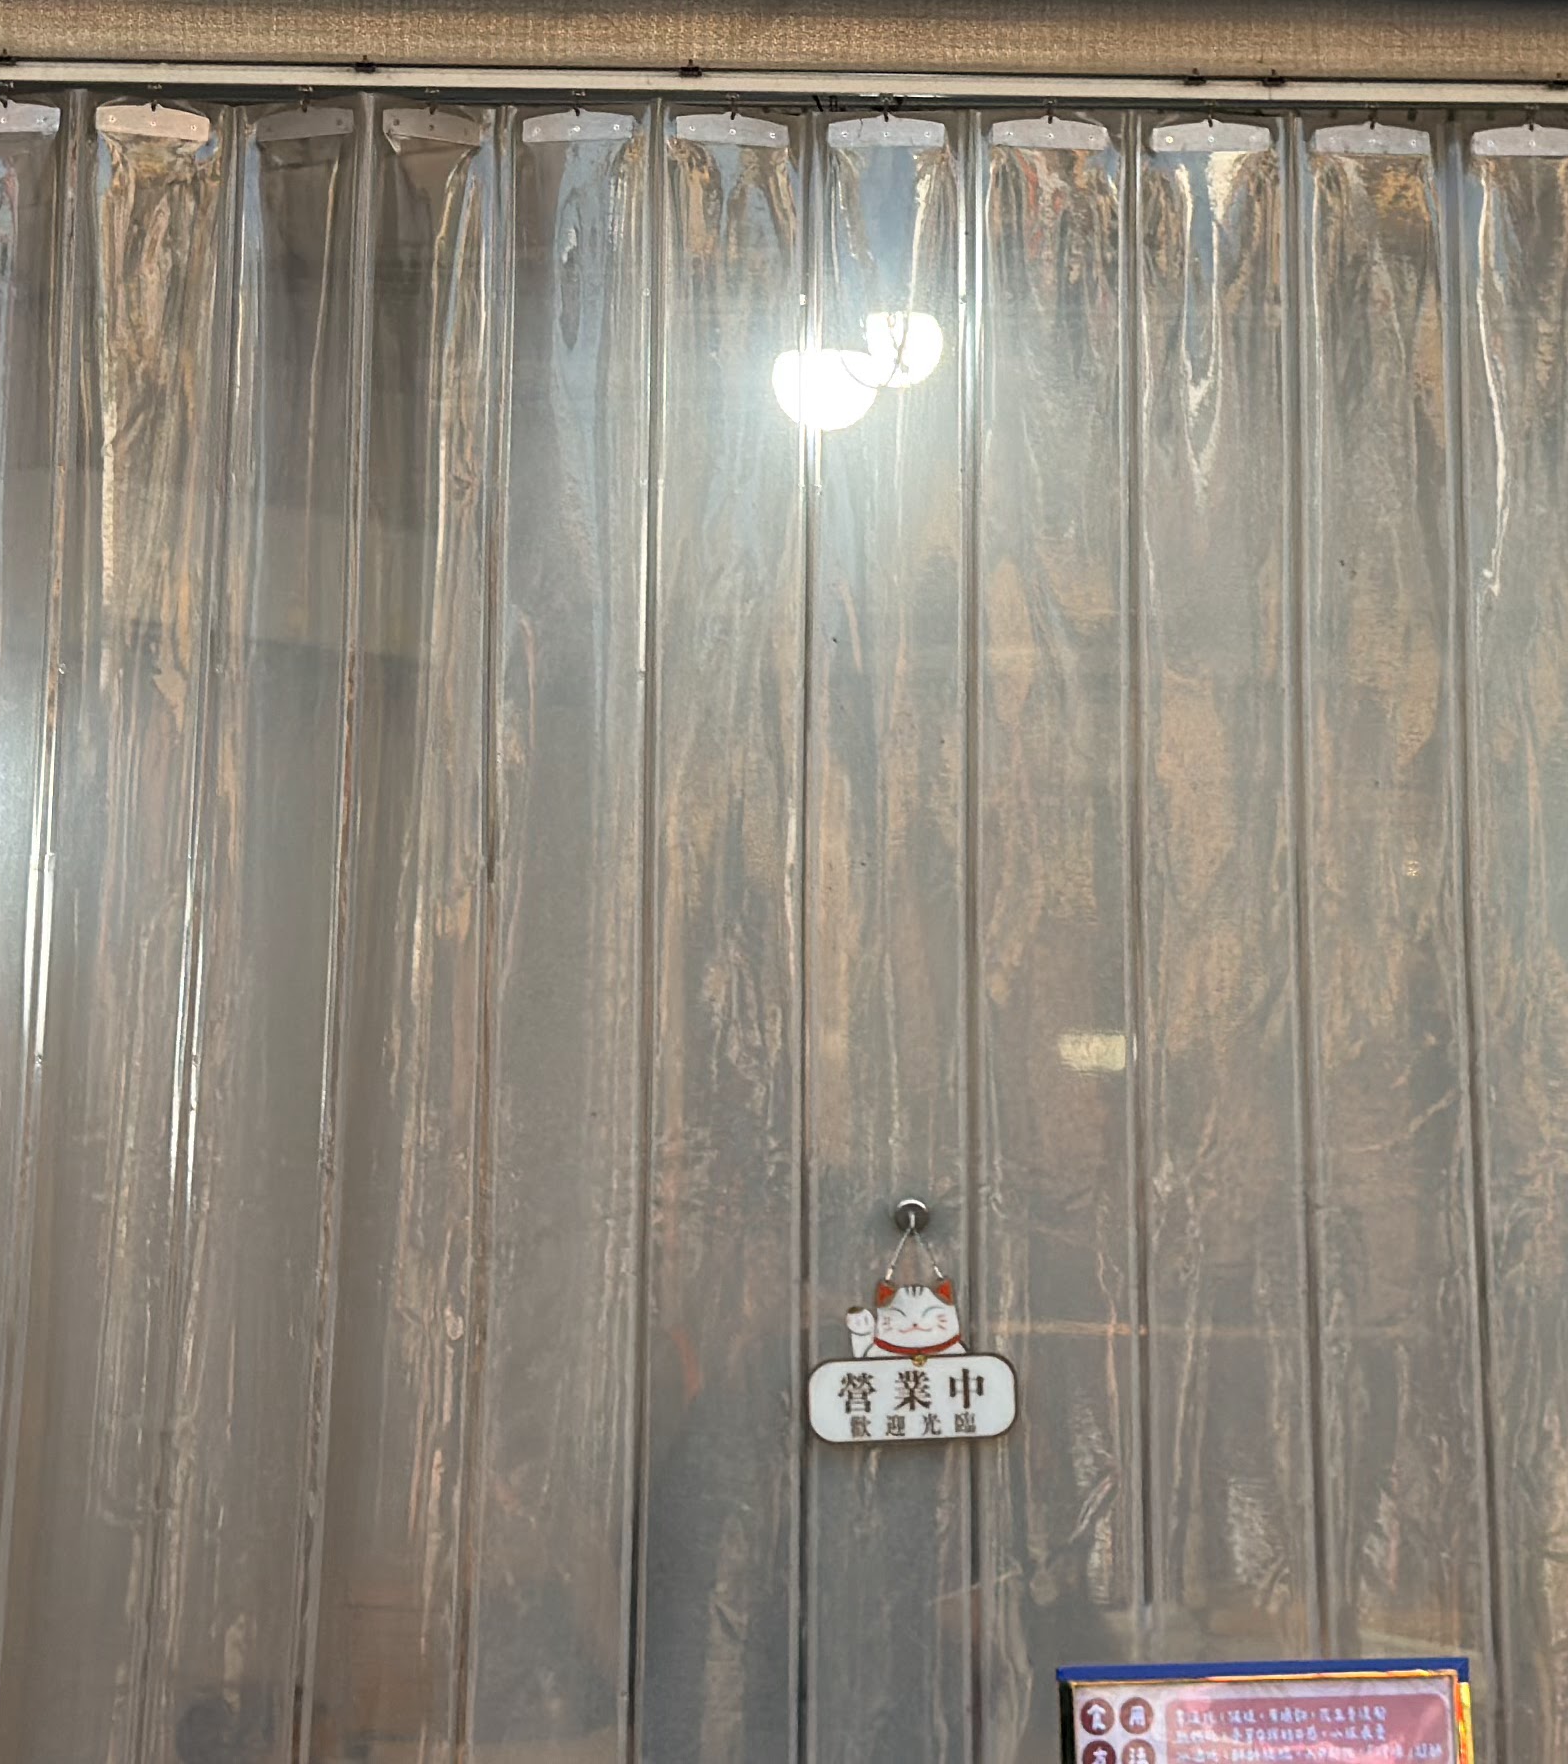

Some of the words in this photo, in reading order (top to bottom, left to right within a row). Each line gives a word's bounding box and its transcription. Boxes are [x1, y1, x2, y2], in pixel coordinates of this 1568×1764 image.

[837, 1368, 985, 1414] 營業中
[850, 1412, 977, 1438] 歡迎光臨
